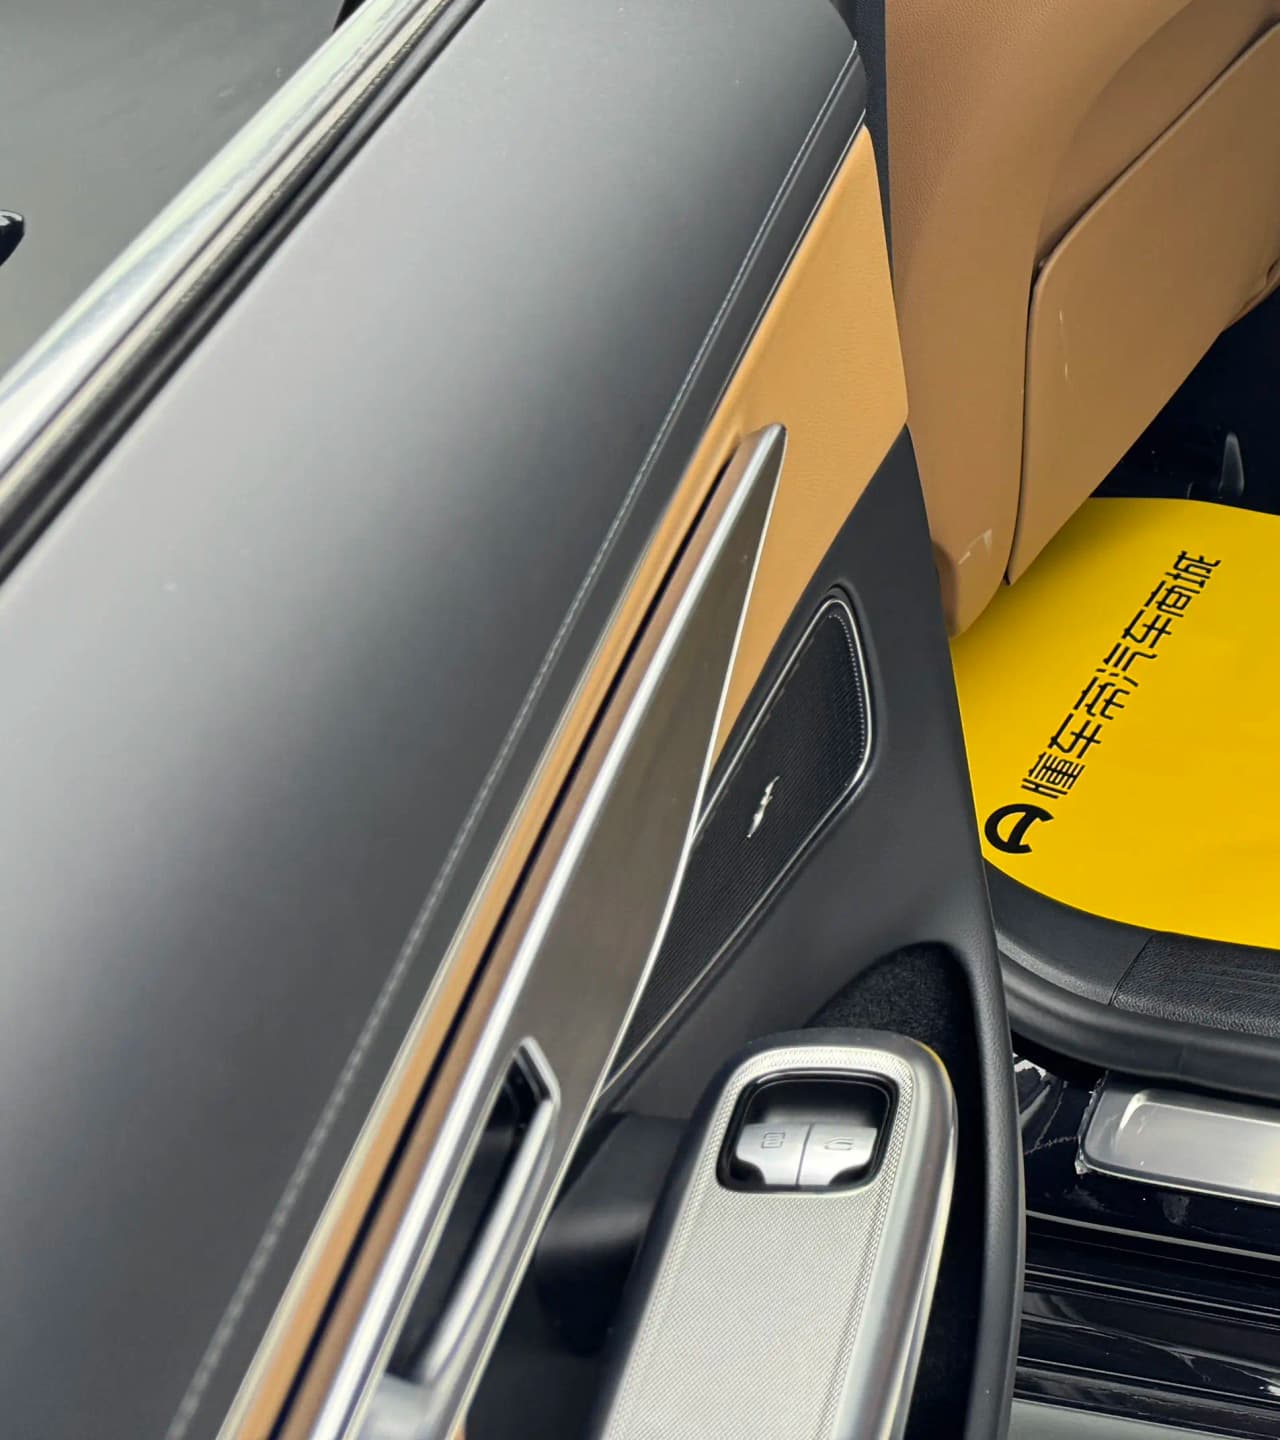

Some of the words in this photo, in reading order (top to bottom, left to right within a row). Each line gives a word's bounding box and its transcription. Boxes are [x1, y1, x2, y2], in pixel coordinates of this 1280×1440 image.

[1021, 550, 1221, 799] 懂车帝汽车商城
